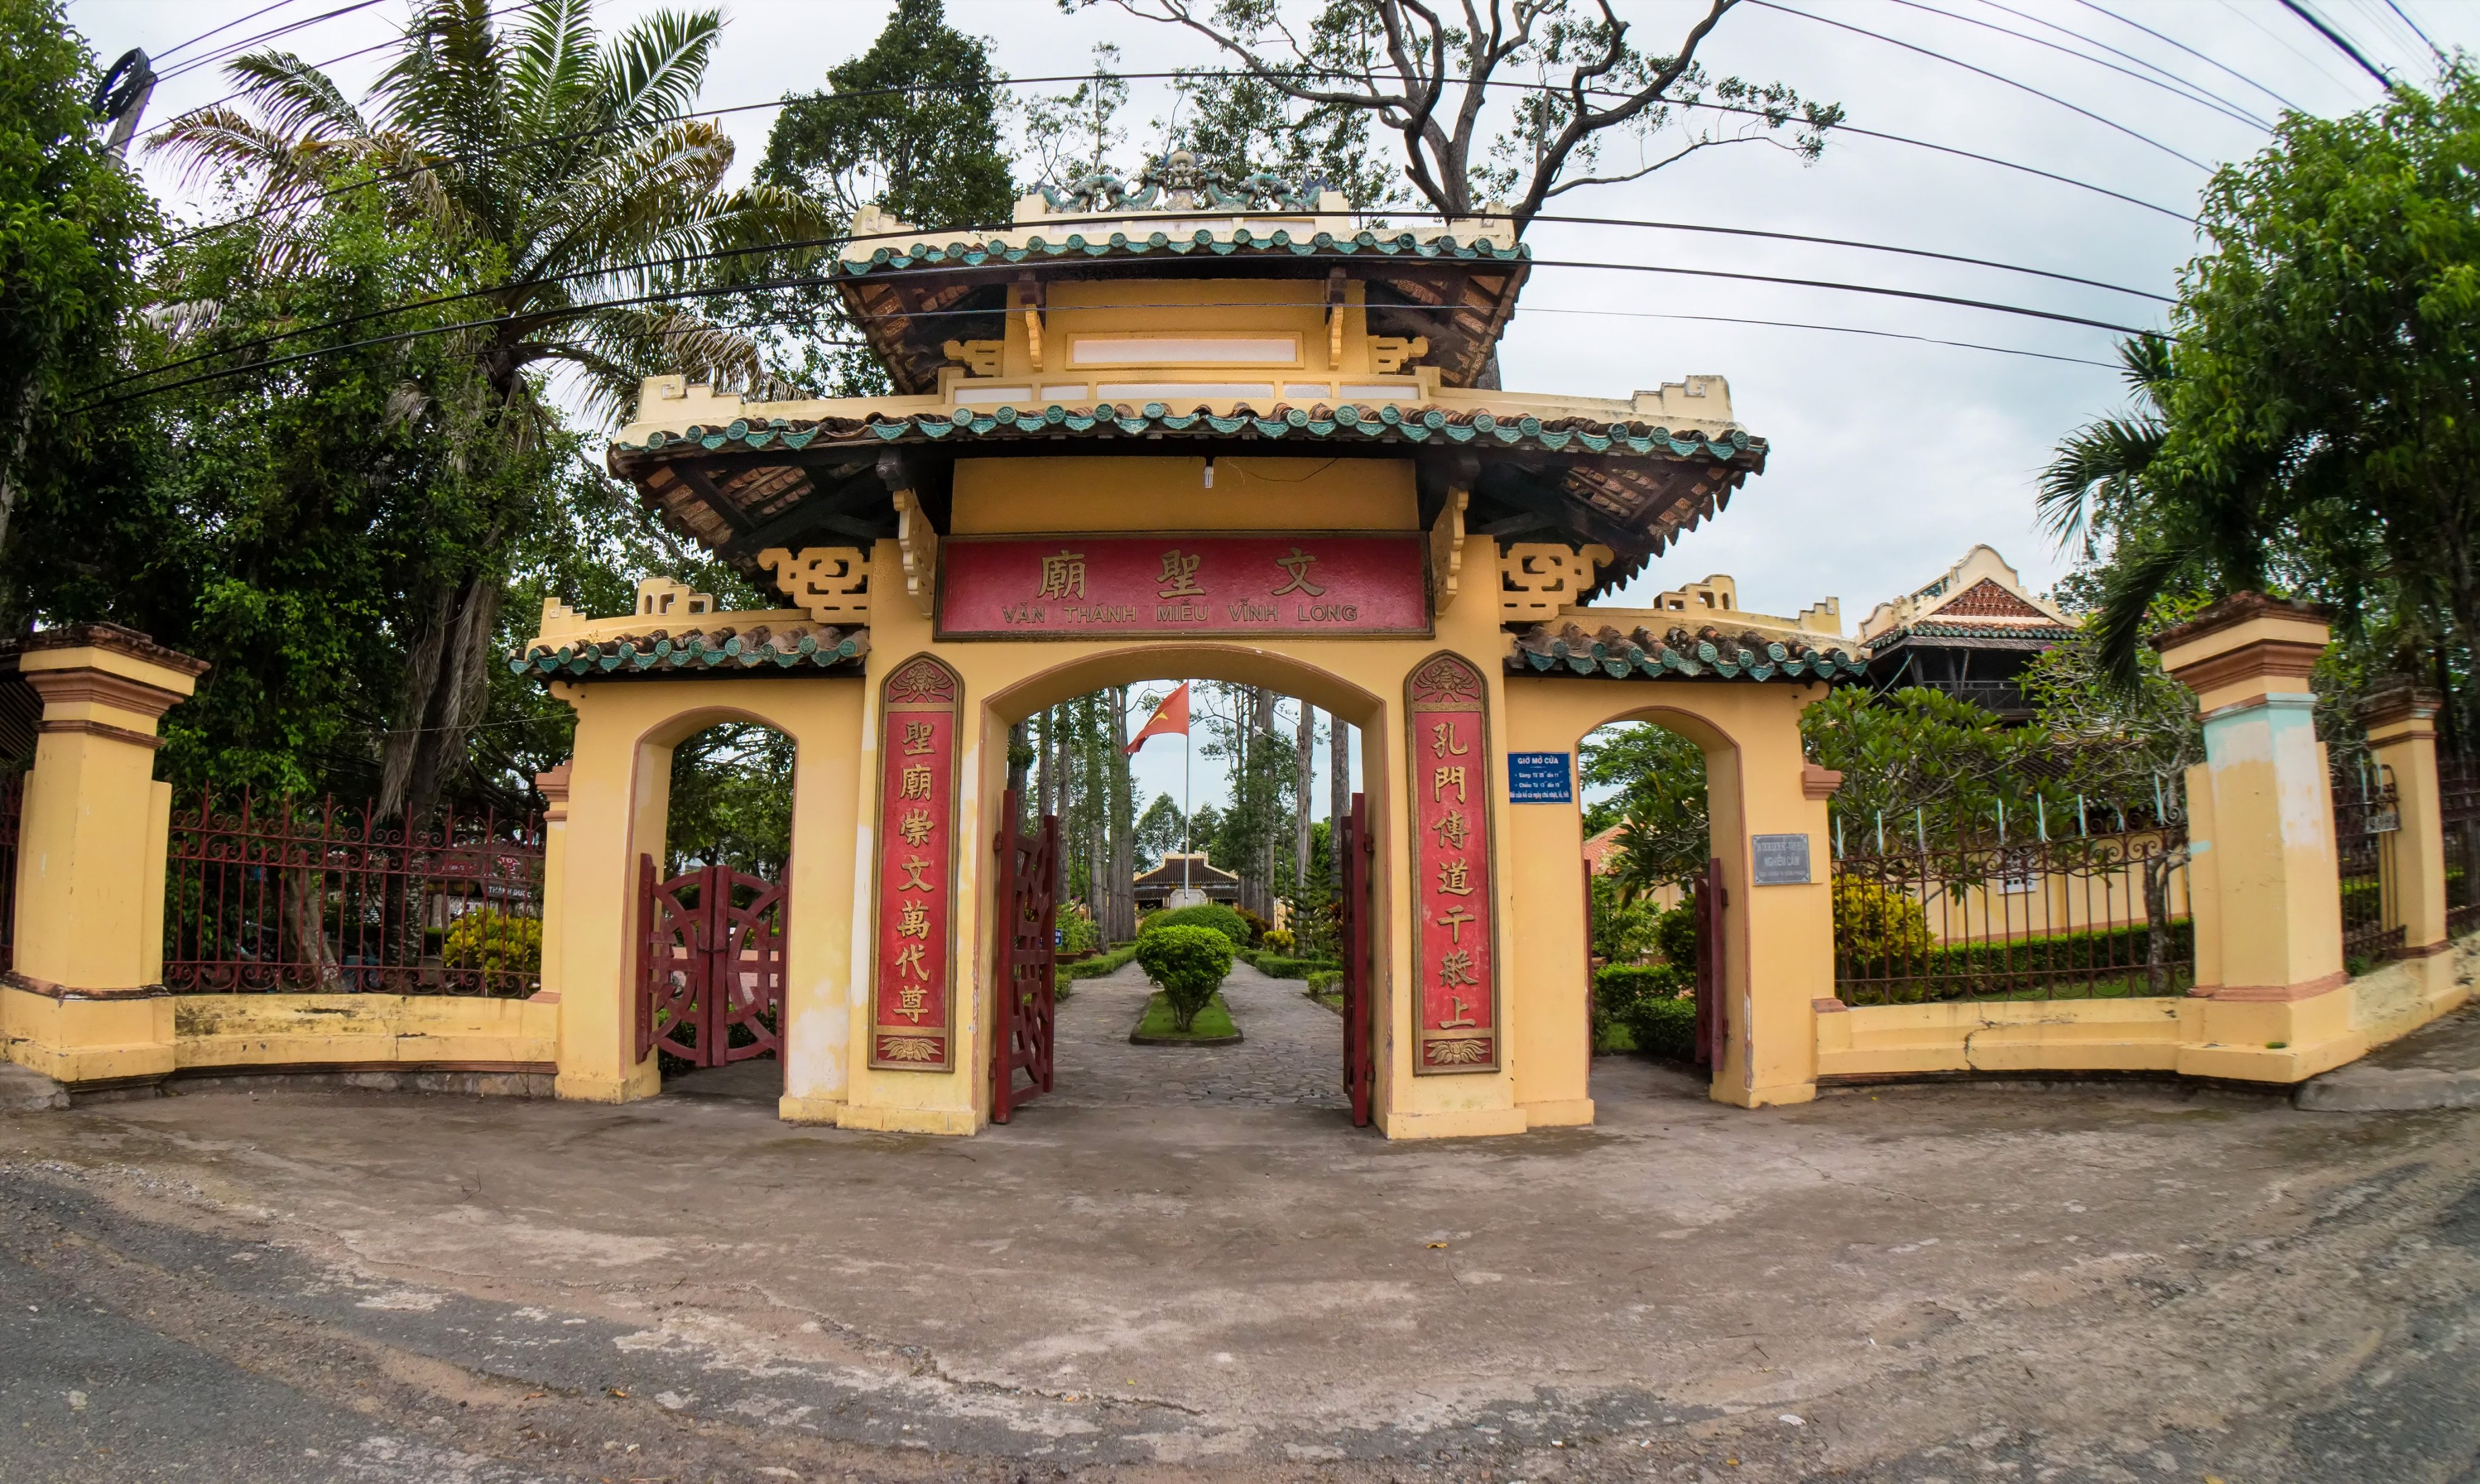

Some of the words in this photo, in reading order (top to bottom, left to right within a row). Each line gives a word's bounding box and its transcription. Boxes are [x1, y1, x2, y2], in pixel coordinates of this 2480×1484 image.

[1001, 602, 1045, 624] VĂN
[1063, 602, 1137, 623] THÁNH
[1156, 598, 1208, 622] MIẾU
[1228, 598, 1278, 622] VĨNH
[1297, 605, 1358, 621] LONG
[1544, 756, 1559, 764] CỬA
